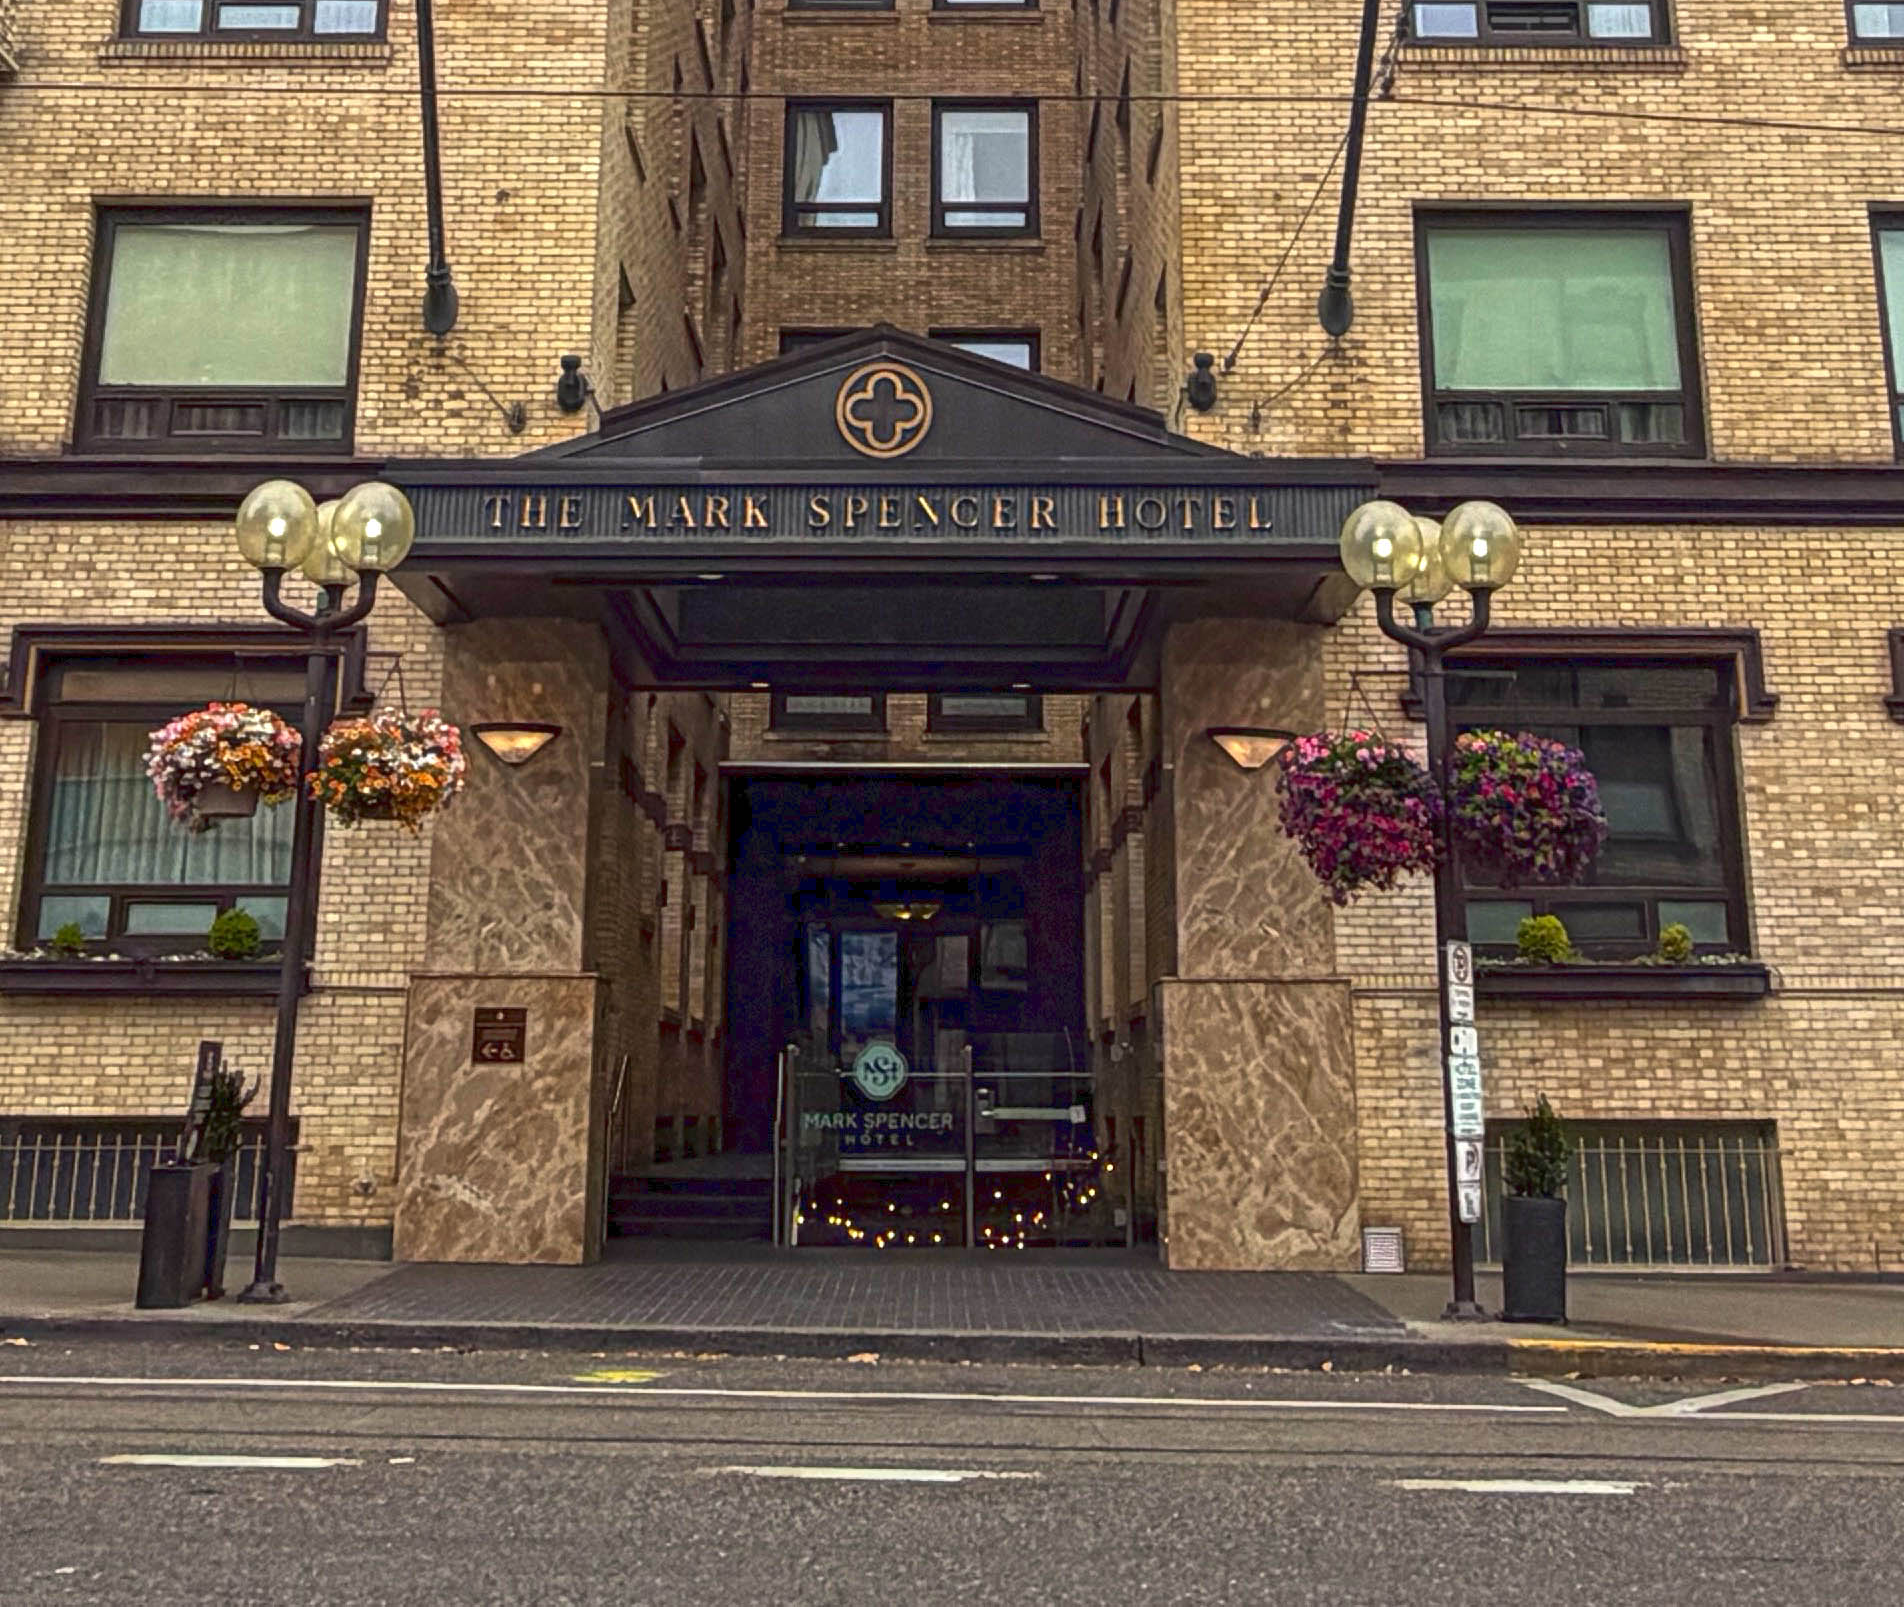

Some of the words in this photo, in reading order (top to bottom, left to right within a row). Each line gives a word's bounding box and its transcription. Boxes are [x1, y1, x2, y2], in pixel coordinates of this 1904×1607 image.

[484, 494, 583, 528] THE
[622, 494, 768, 528] MARK
[807, 495, 1057, 528] SPENCER
[1099, 495, 1272, 529] HOTEL
[804, 1112, 857, 1130] MARK
[864, 1112, 953, 1130] SPENCER
[846, 1134, 915, 1146] HOTEL
